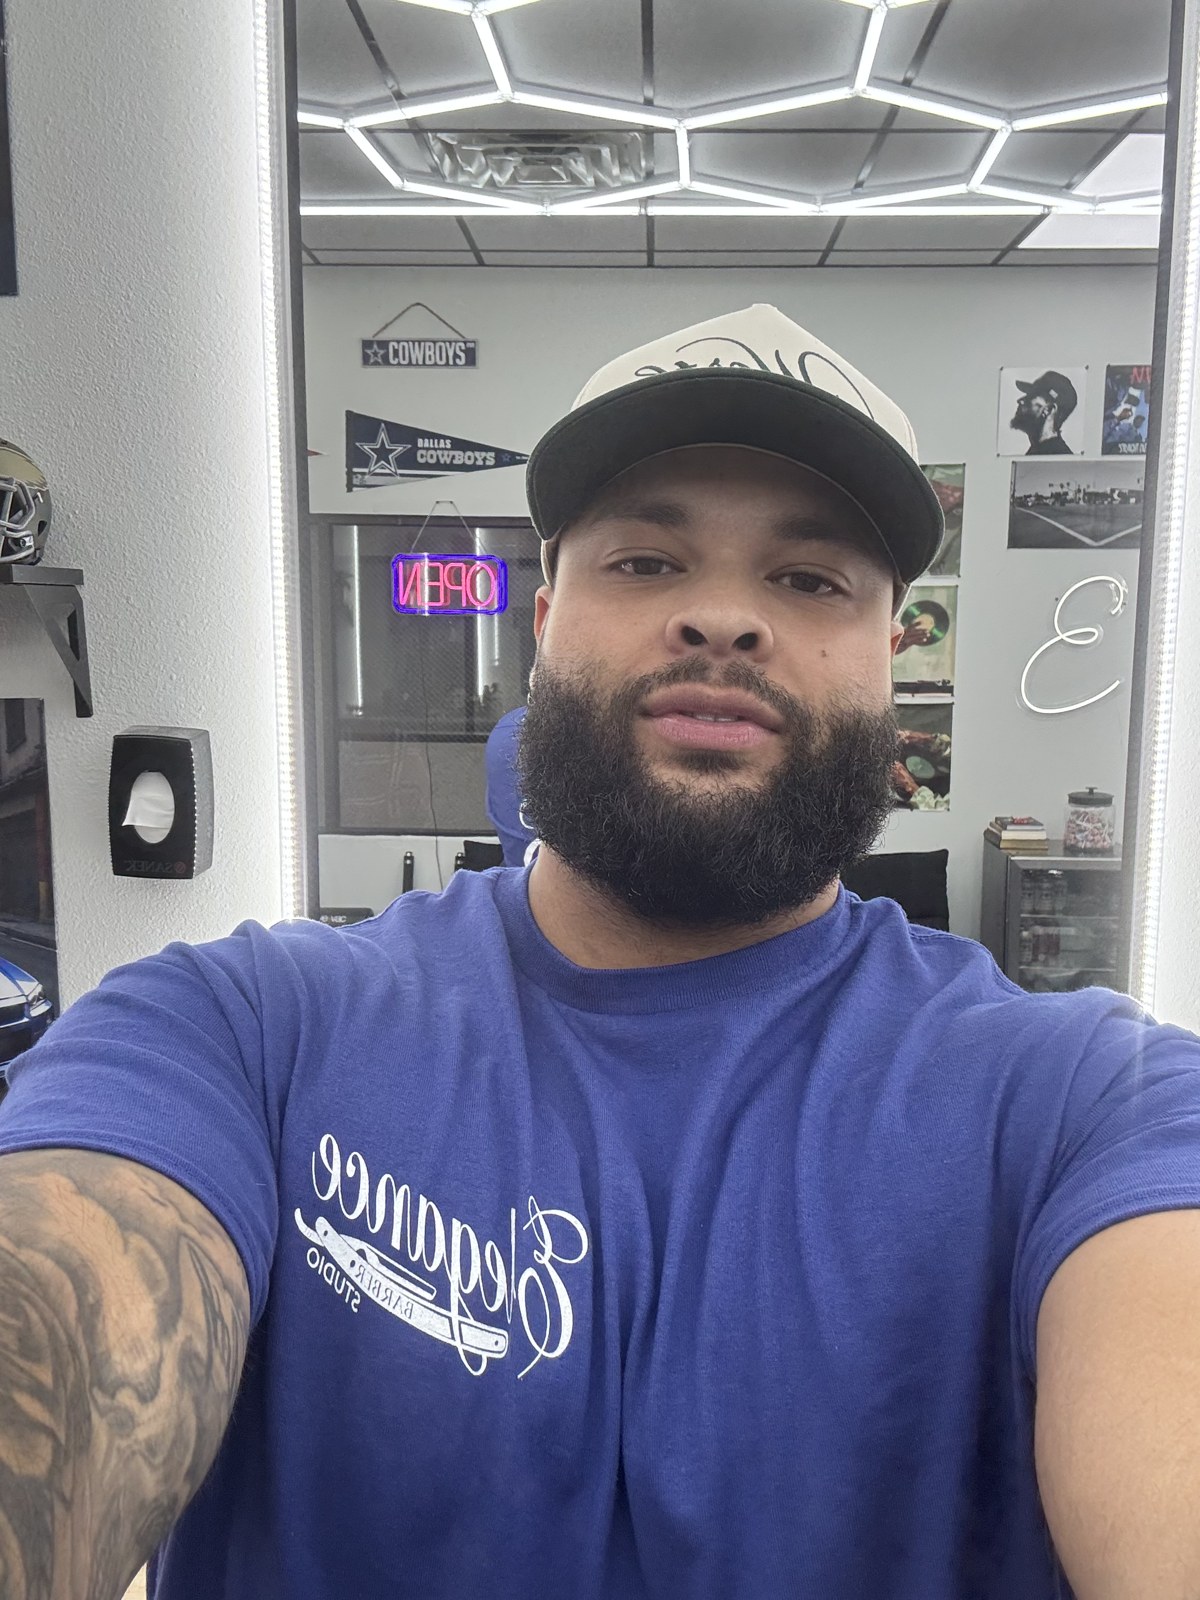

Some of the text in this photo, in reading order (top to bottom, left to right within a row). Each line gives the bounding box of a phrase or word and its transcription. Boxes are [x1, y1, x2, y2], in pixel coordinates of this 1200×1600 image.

[388, 341, 466, 365] COWBOYS
[417, 438, 452, 449] DALLAS
[416, 449, 496, 466] COWBOYS
[1020, 575, 1124, 714] E
